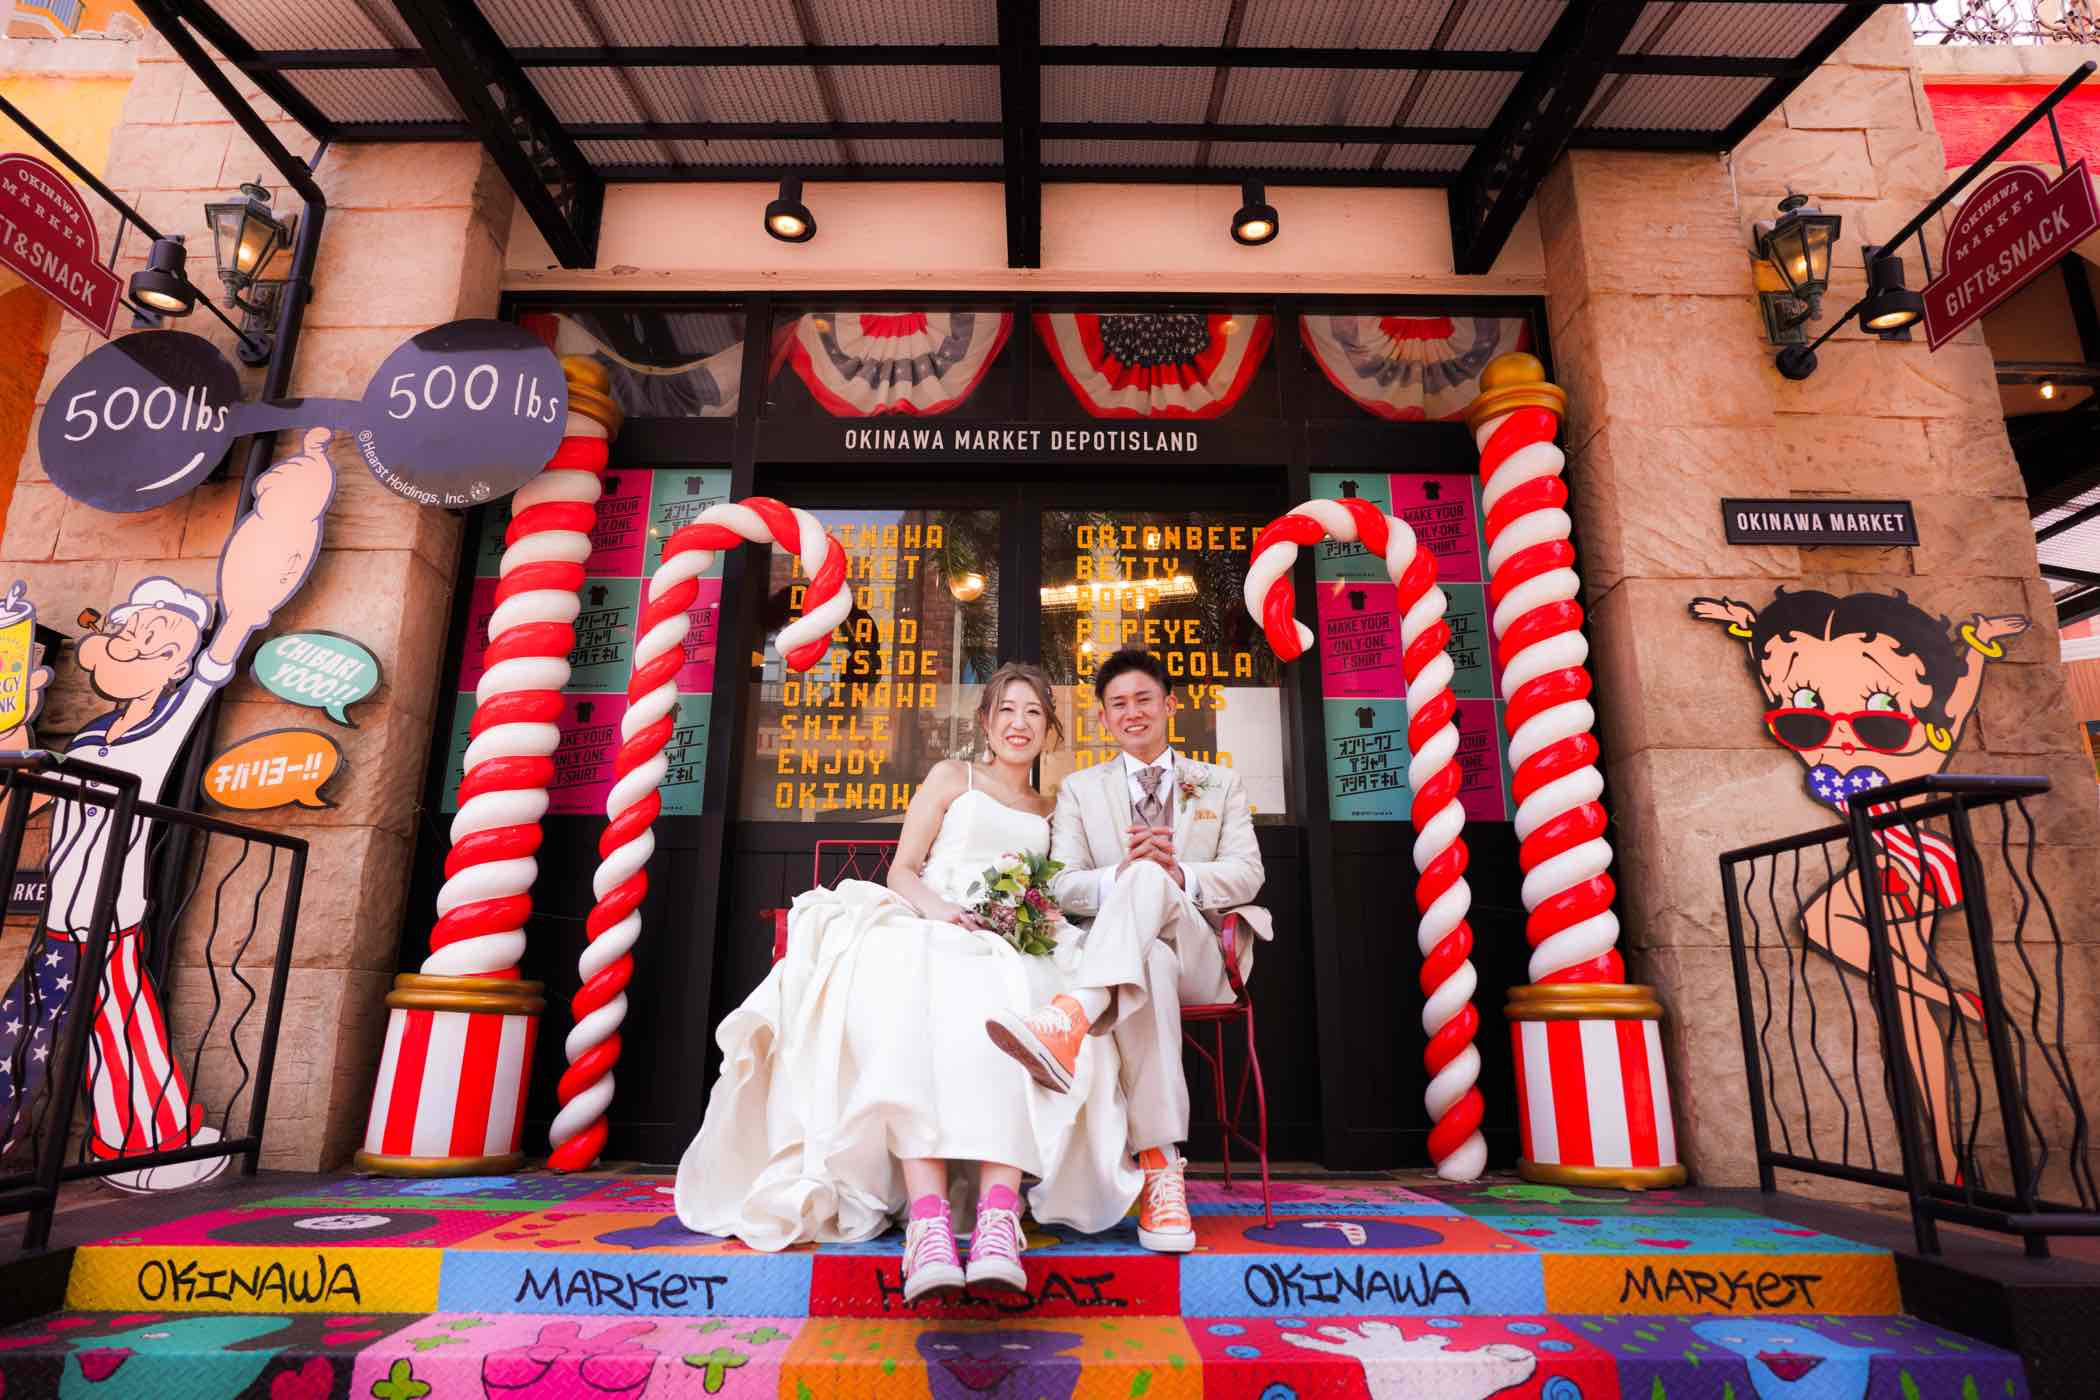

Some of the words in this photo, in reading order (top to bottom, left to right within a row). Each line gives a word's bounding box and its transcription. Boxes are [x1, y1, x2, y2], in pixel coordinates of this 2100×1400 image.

[19, 168, 81, 225] OKINAWA
[1961, 181, 2019, 235] OKINAWA
[1, 176, 86, 249] MARKET
[1956, 190, 2035, 261] MARKET
[1945, 204, 2072, 317] GIFT&SNACK
[388, 363, 500, 420] 500
[513, 373, 560, 424] lbs
[845, 430, 945, 450] OKINAWA
[954, 430, 1042, 451] MARKET
[1050, 431, 1199, 452] DEPOTISLAND
[386, 473, 441, 505] Holdings,
[445, 492, 470, 504] Inc.
[826, 524, 944, 548] INAWA
[1737, 512, 1824, 532] OKINAWA
[1829, 513, 1905, 533] MARKET
[1077, 556, 1180, 581] BETTY
[789, 585, 897, 611] DOT
[1077, 618, 1201, 645] POPEYE
[275, 637, 366, 681] CHIBARI
[784, 648, 938, 676] ASIDE
[783, 681, 938, 708] OKINAWA
[780, 714, 890, 741] SMILE
[777, 747, 887, 776] ENJOY
[775, 781, 924, 810] OKINAW
[13, 883, 48, 902] RKE
[137, 1255, 361, 1306] OKINAWA
[1243, 1261, 1472, 1308] OKINAWA
